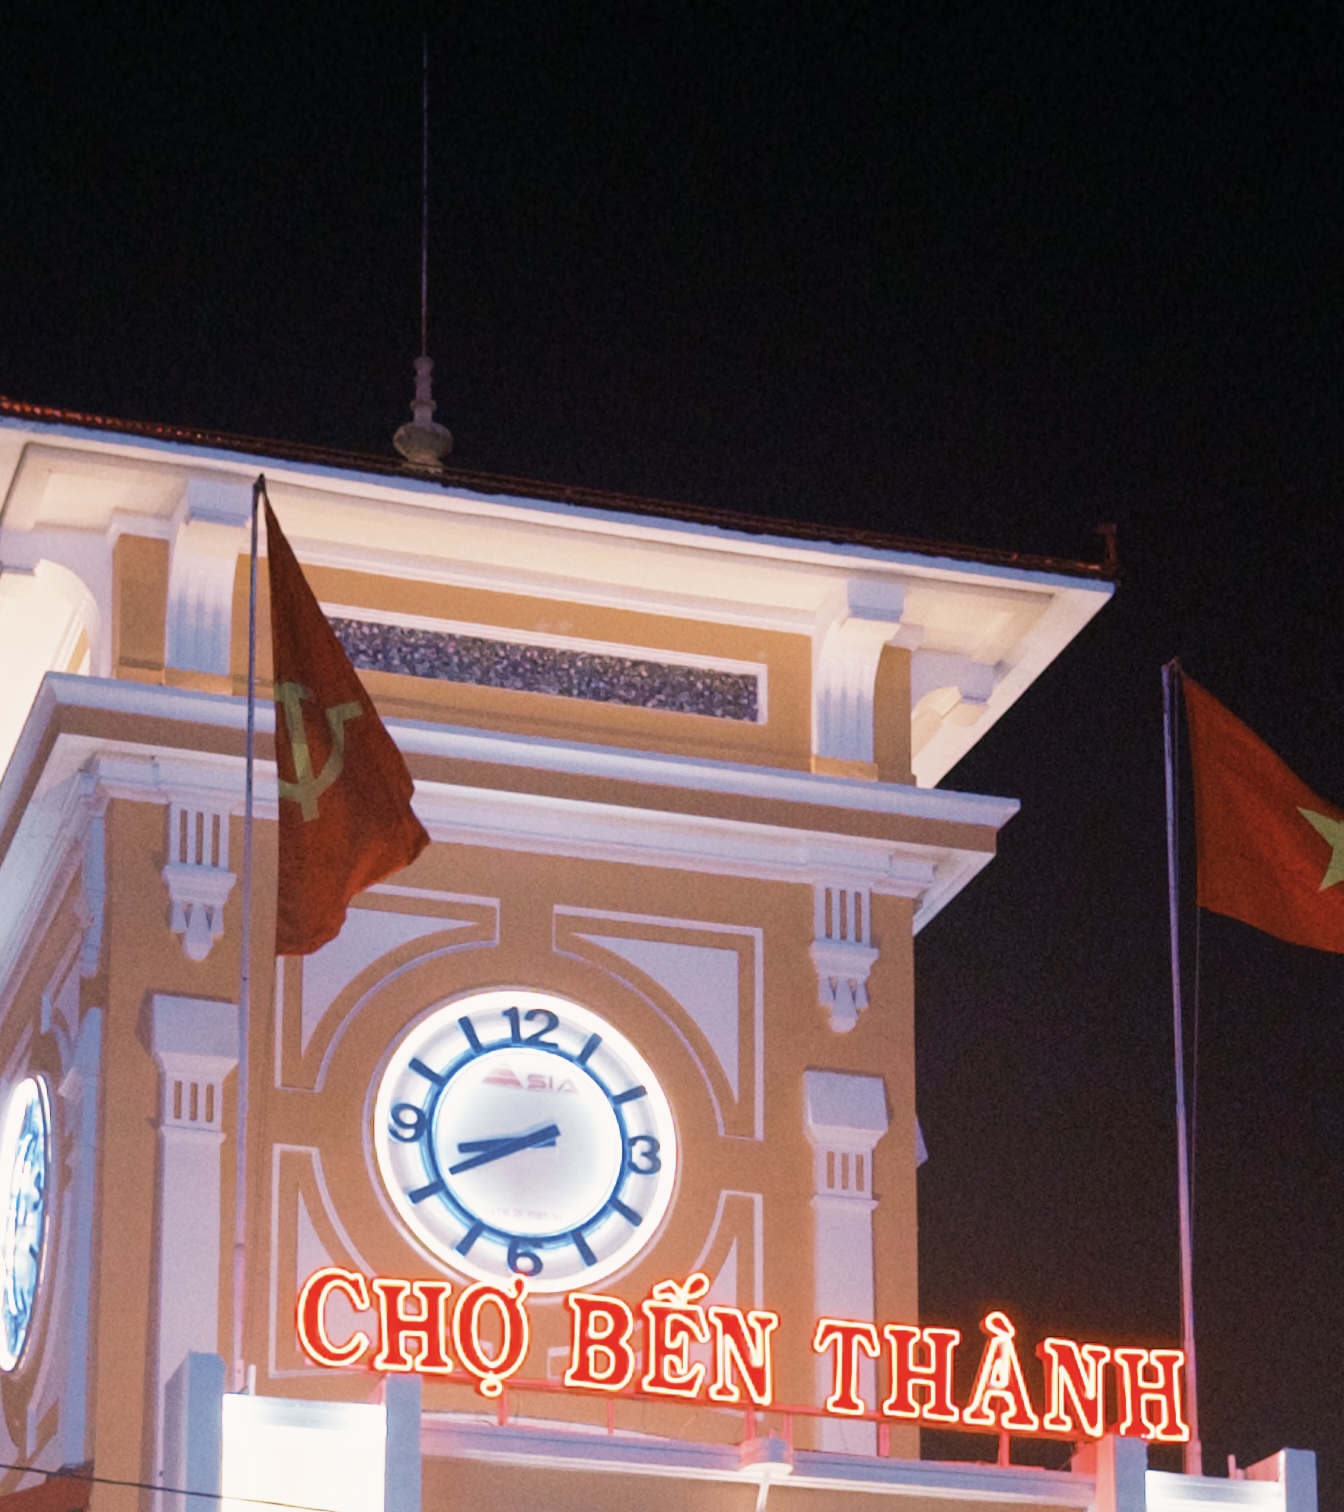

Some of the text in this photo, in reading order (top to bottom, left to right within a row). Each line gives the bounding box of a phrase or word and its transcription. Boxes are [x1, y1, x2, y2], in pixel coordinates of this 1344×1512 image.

[502, 1006, 560, 1049] 12
[388, 1103, 427, 1144] 9
[627, 1134, 662, 1176] 3
[506, 1240, 544, 1278] 6
[296, 1266, 1190, 1443] CHỢ BẾN THÀNH
